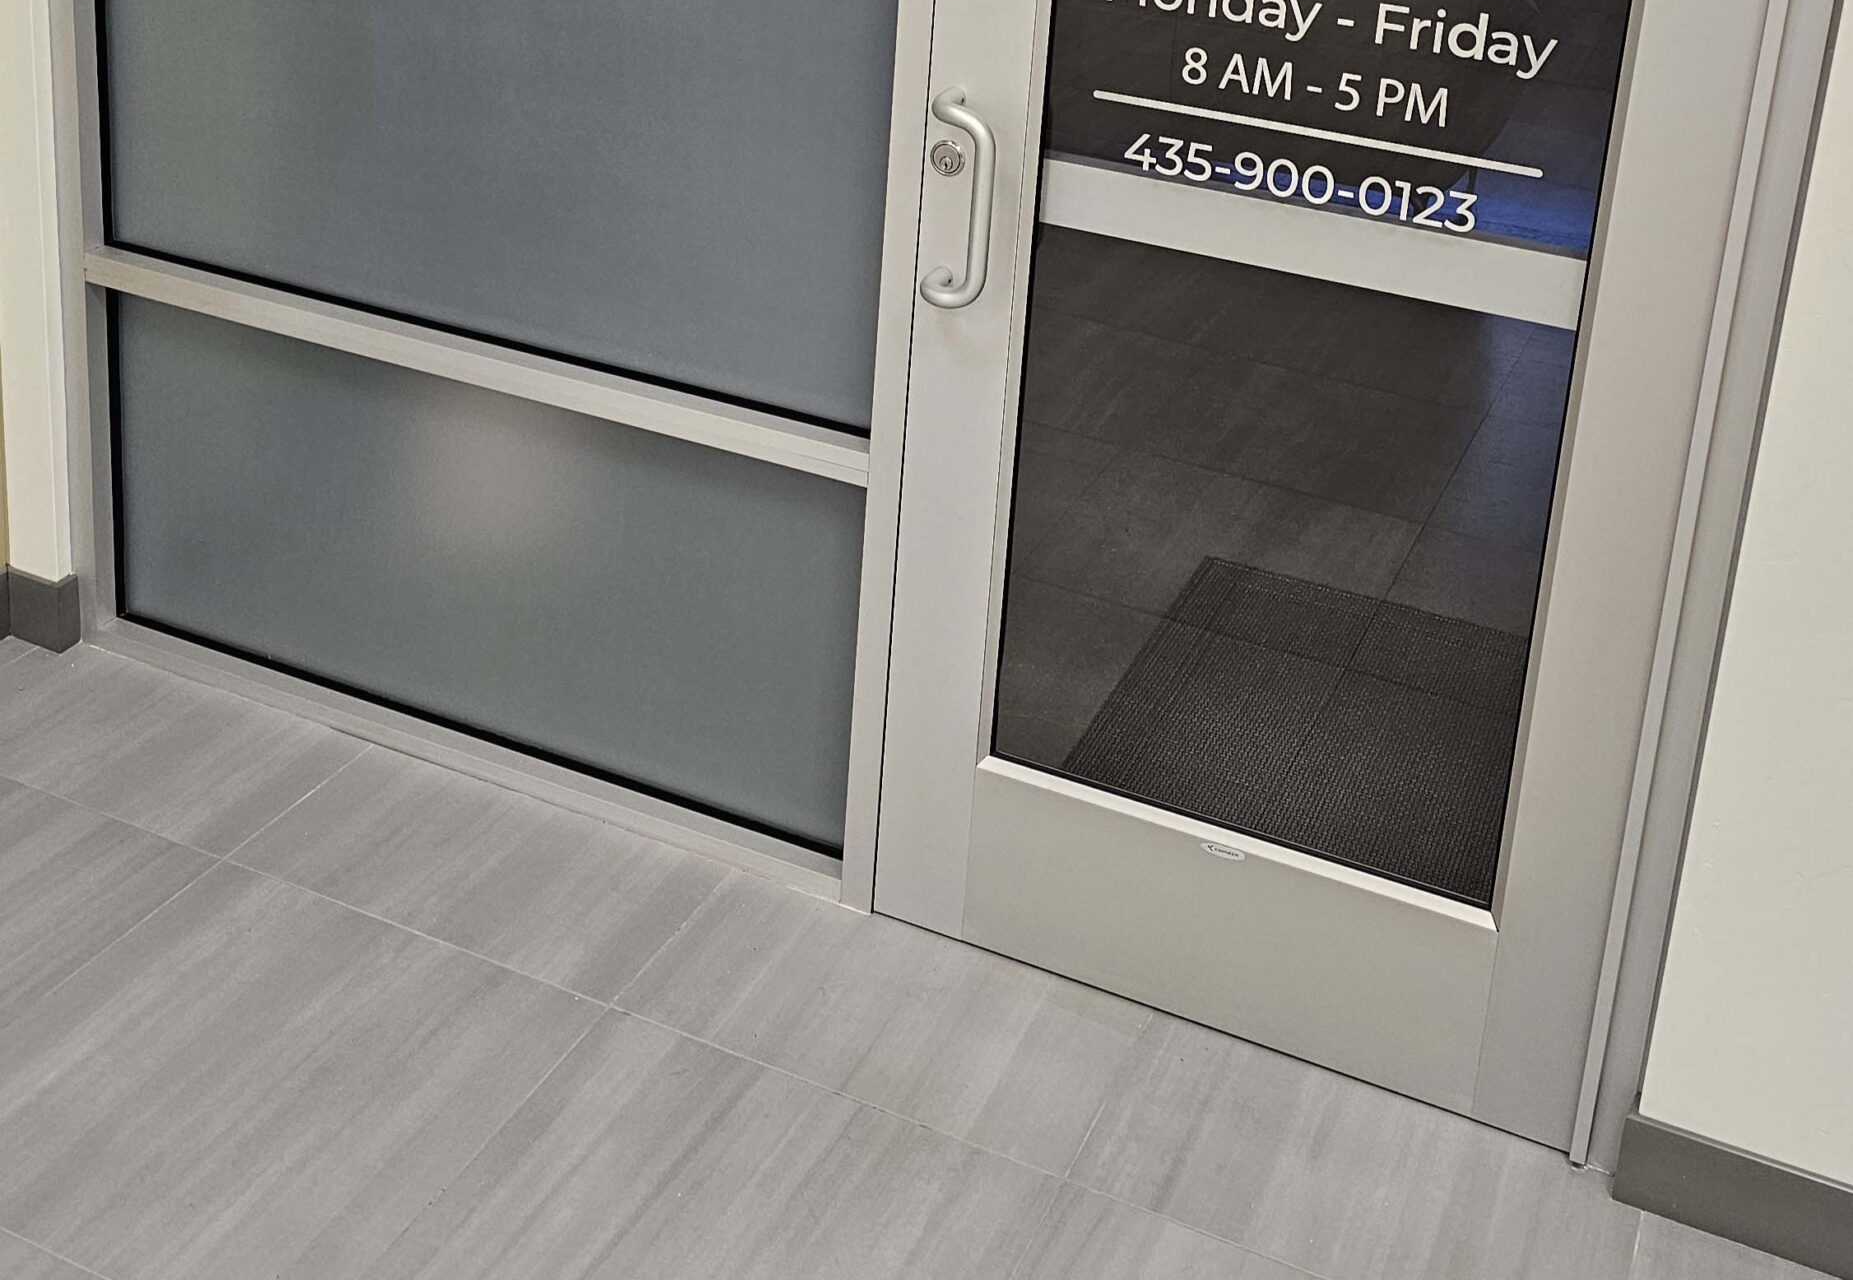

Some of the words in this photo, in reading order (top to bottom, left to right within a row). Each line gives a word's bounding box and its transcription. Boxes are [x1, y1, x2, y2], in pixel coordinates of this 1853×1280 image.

[1374, 2, 1558, 80] Friday
[1181, 47, 1208, 85] 8
[1218, 53, 1293, 101] AM
[1334, 72, 1362, 111] 5
[1376, 77, 1448, 128] PM
[1123, 133, 1478, 233] 435-900-0123
